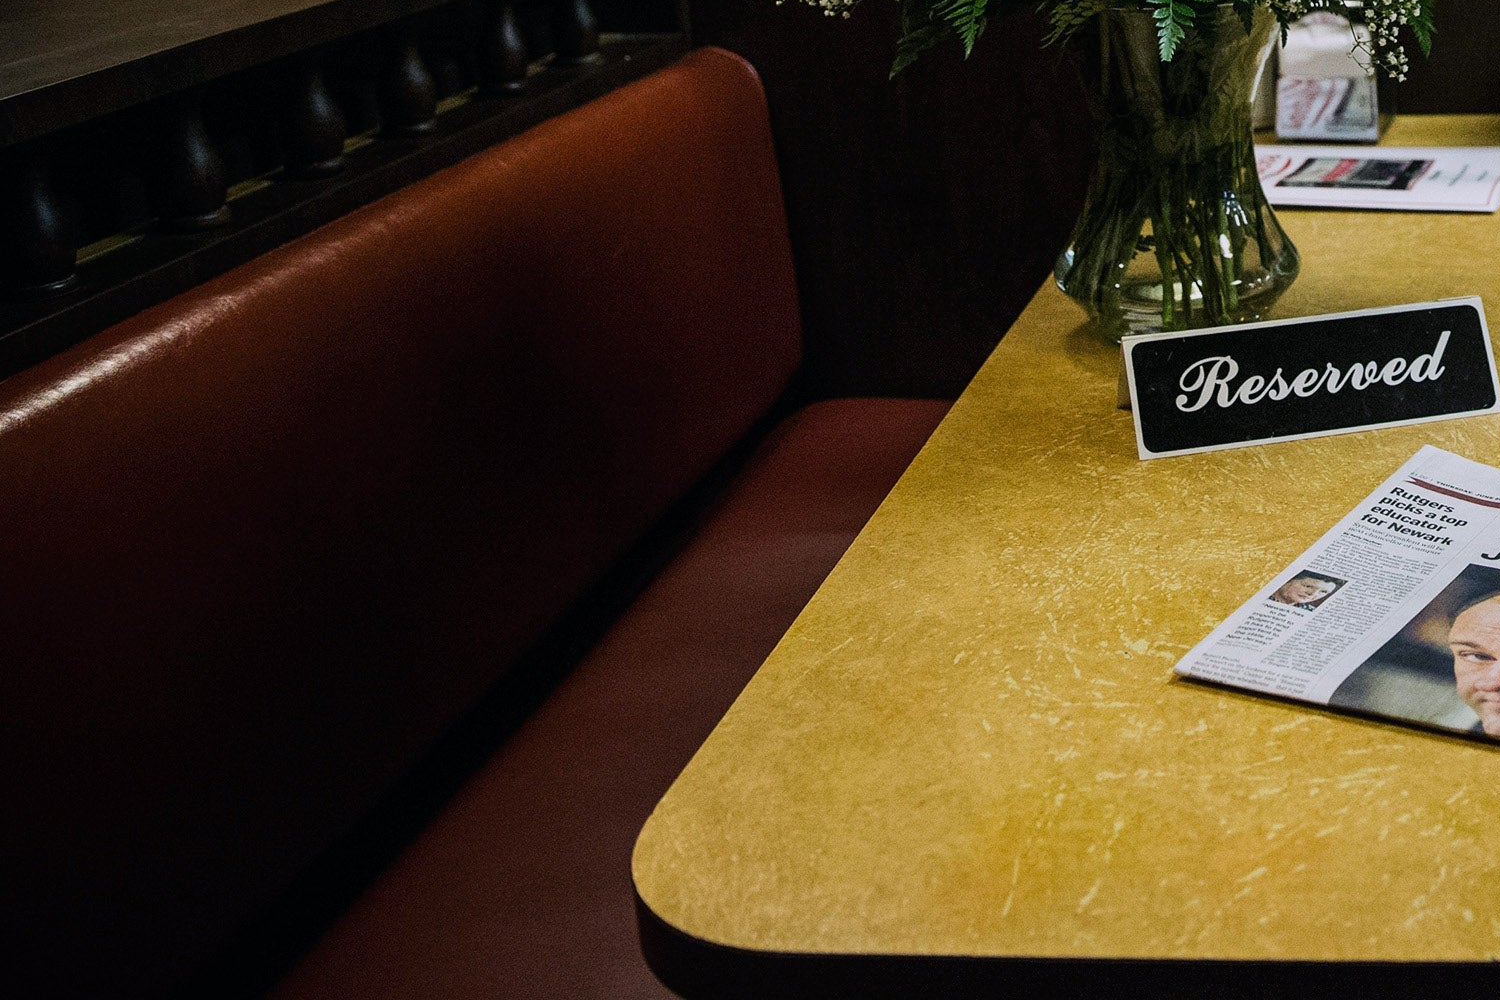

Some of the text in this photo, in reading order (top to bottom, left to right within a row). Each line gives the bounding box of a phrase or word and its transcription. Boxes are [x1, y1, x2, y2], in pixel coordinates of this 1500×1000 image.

[1175, 330, 1451, 413] Reserved
[1390, 487, 1455, 513] Rutgers
[1475, 492, 1494, 500] JUNE
[1371, 505, 1448, 532] educator
[1378, 496, 1468, 528] picks a top
[1360, 513, 1390, 529] for
[1387, 521, 1454, 546] Newark
